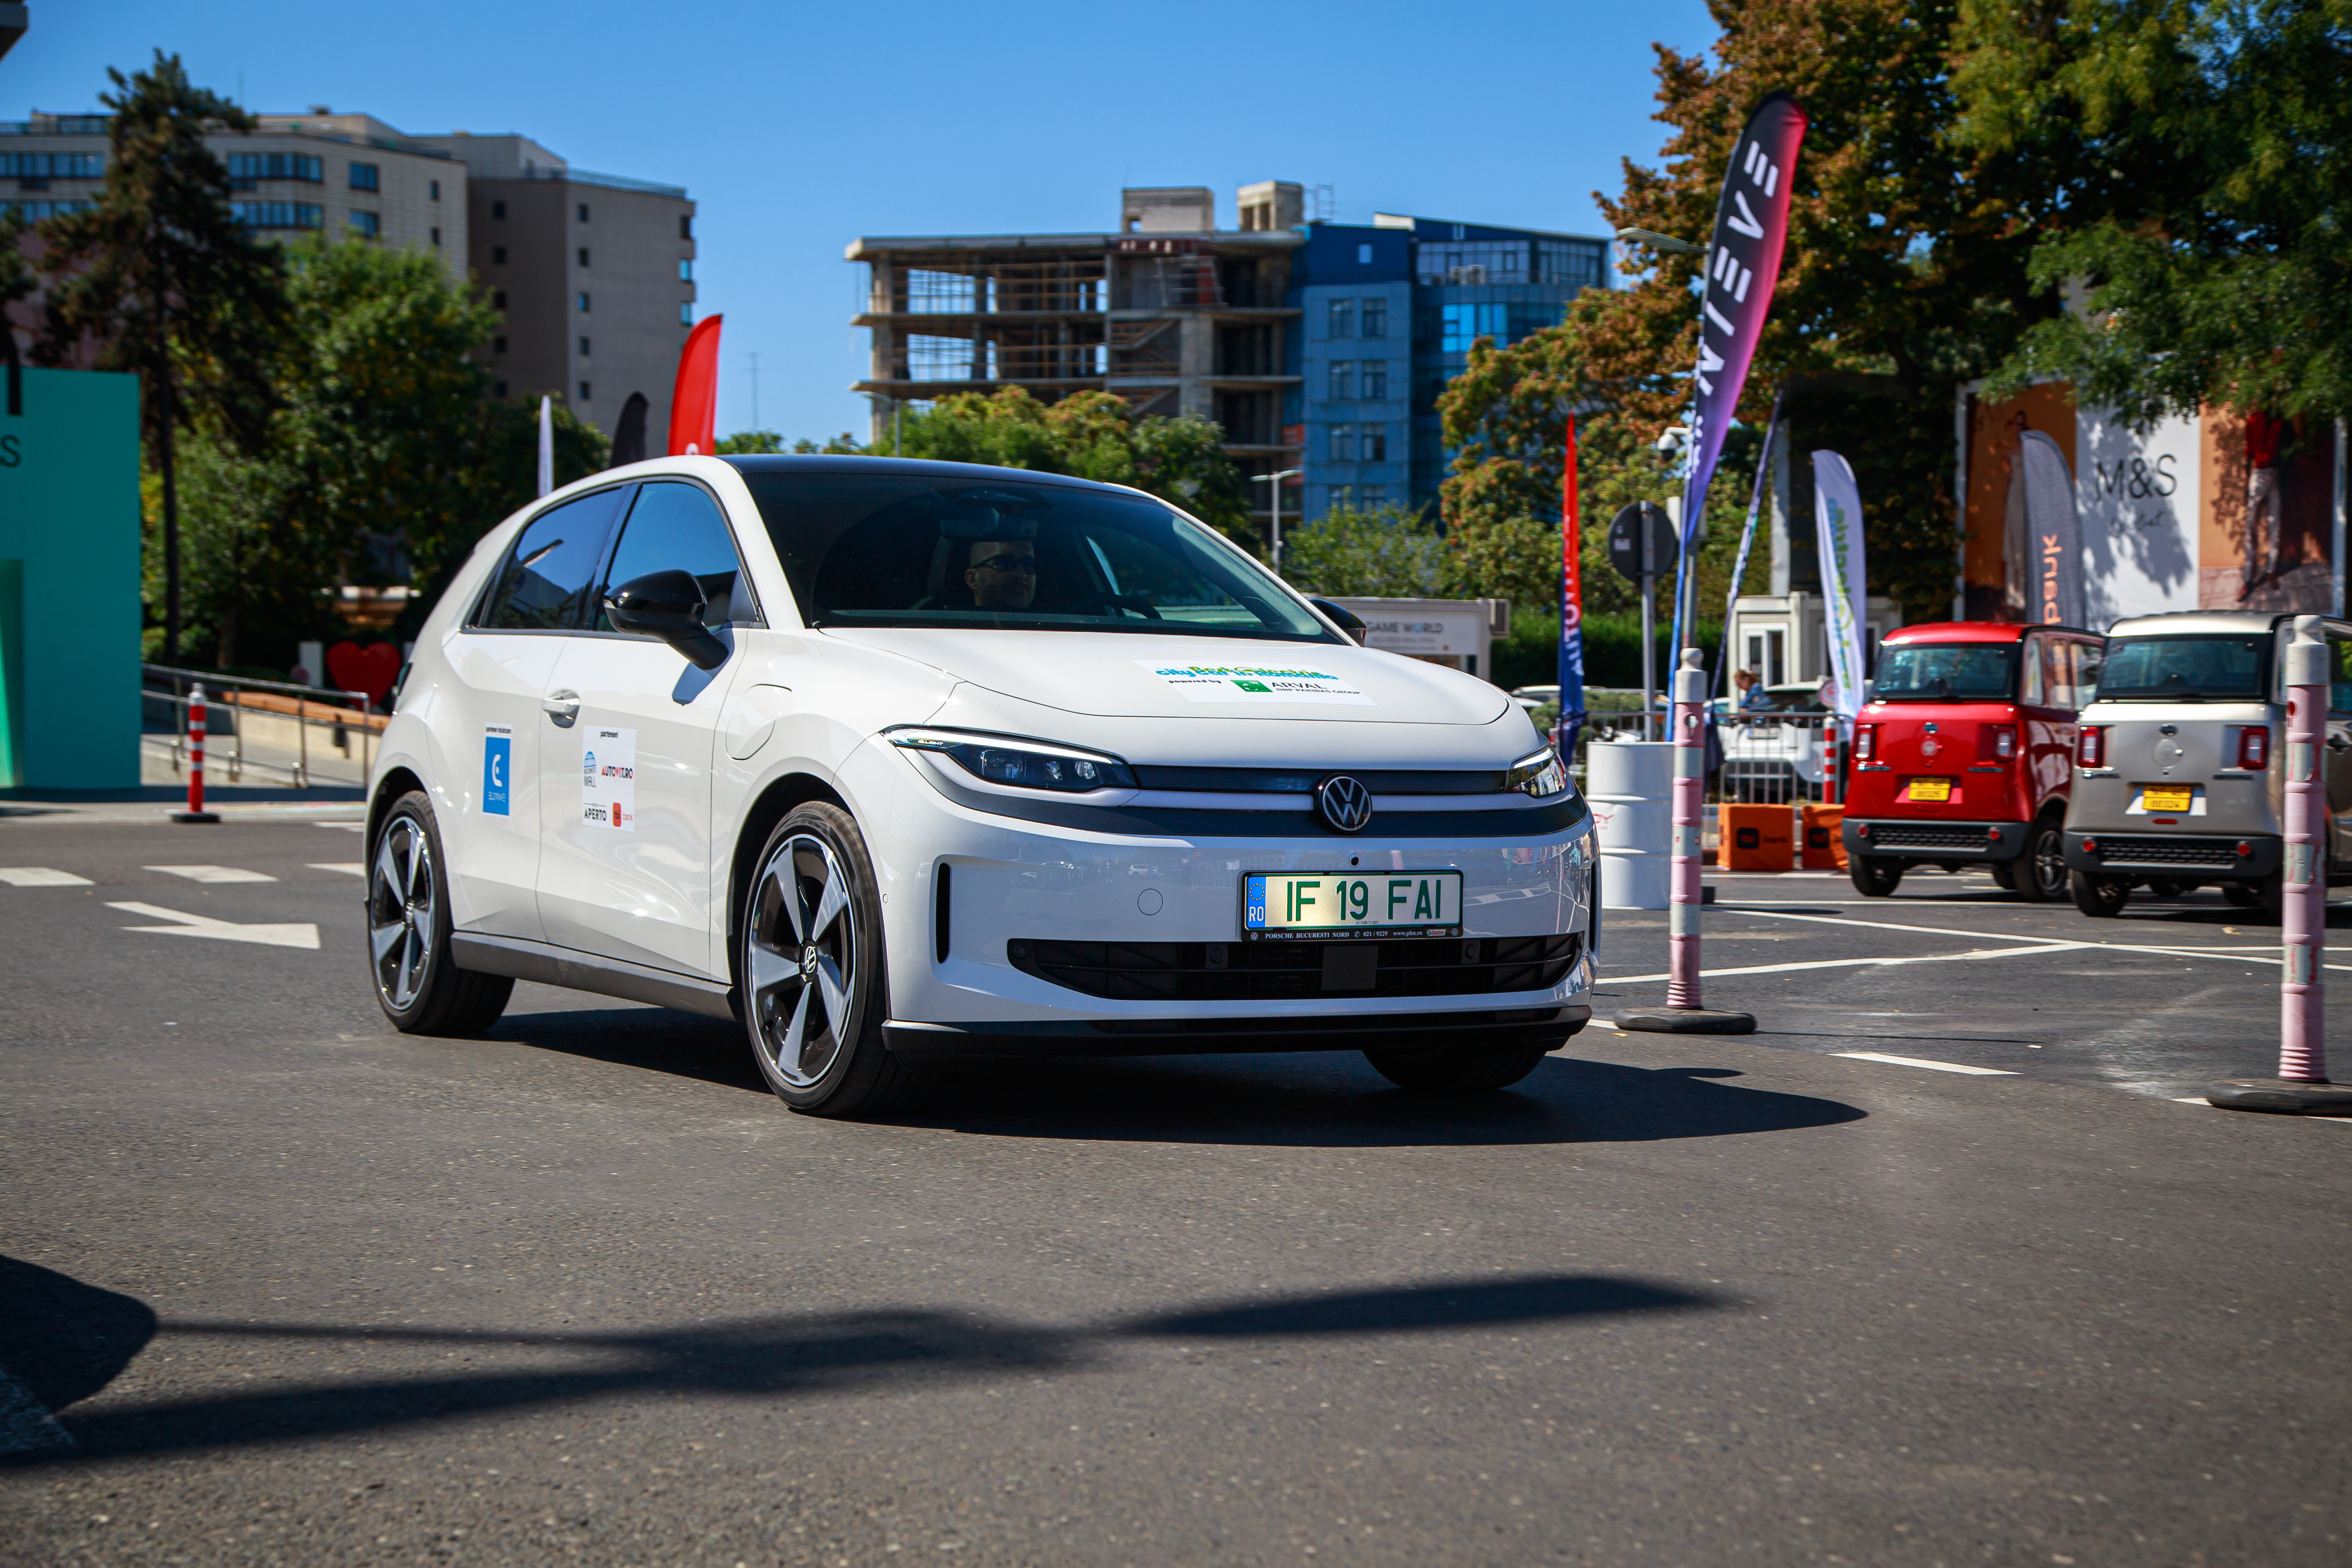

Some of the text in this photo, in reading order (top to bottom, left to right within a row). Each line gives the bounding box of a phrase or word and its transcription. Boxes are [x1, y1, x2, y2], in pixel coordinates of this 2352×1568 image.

[2095, 453, 2177, 502] M&S
[1366, 622, 1444, 634] GAME WORLD
[1156, 669, 1196, 677] city
[584, 807, 607, 821] APERTO
[1287, 879, 1441, 922] IF 19 FAI
[1249, 906, 1264, 922] RO
